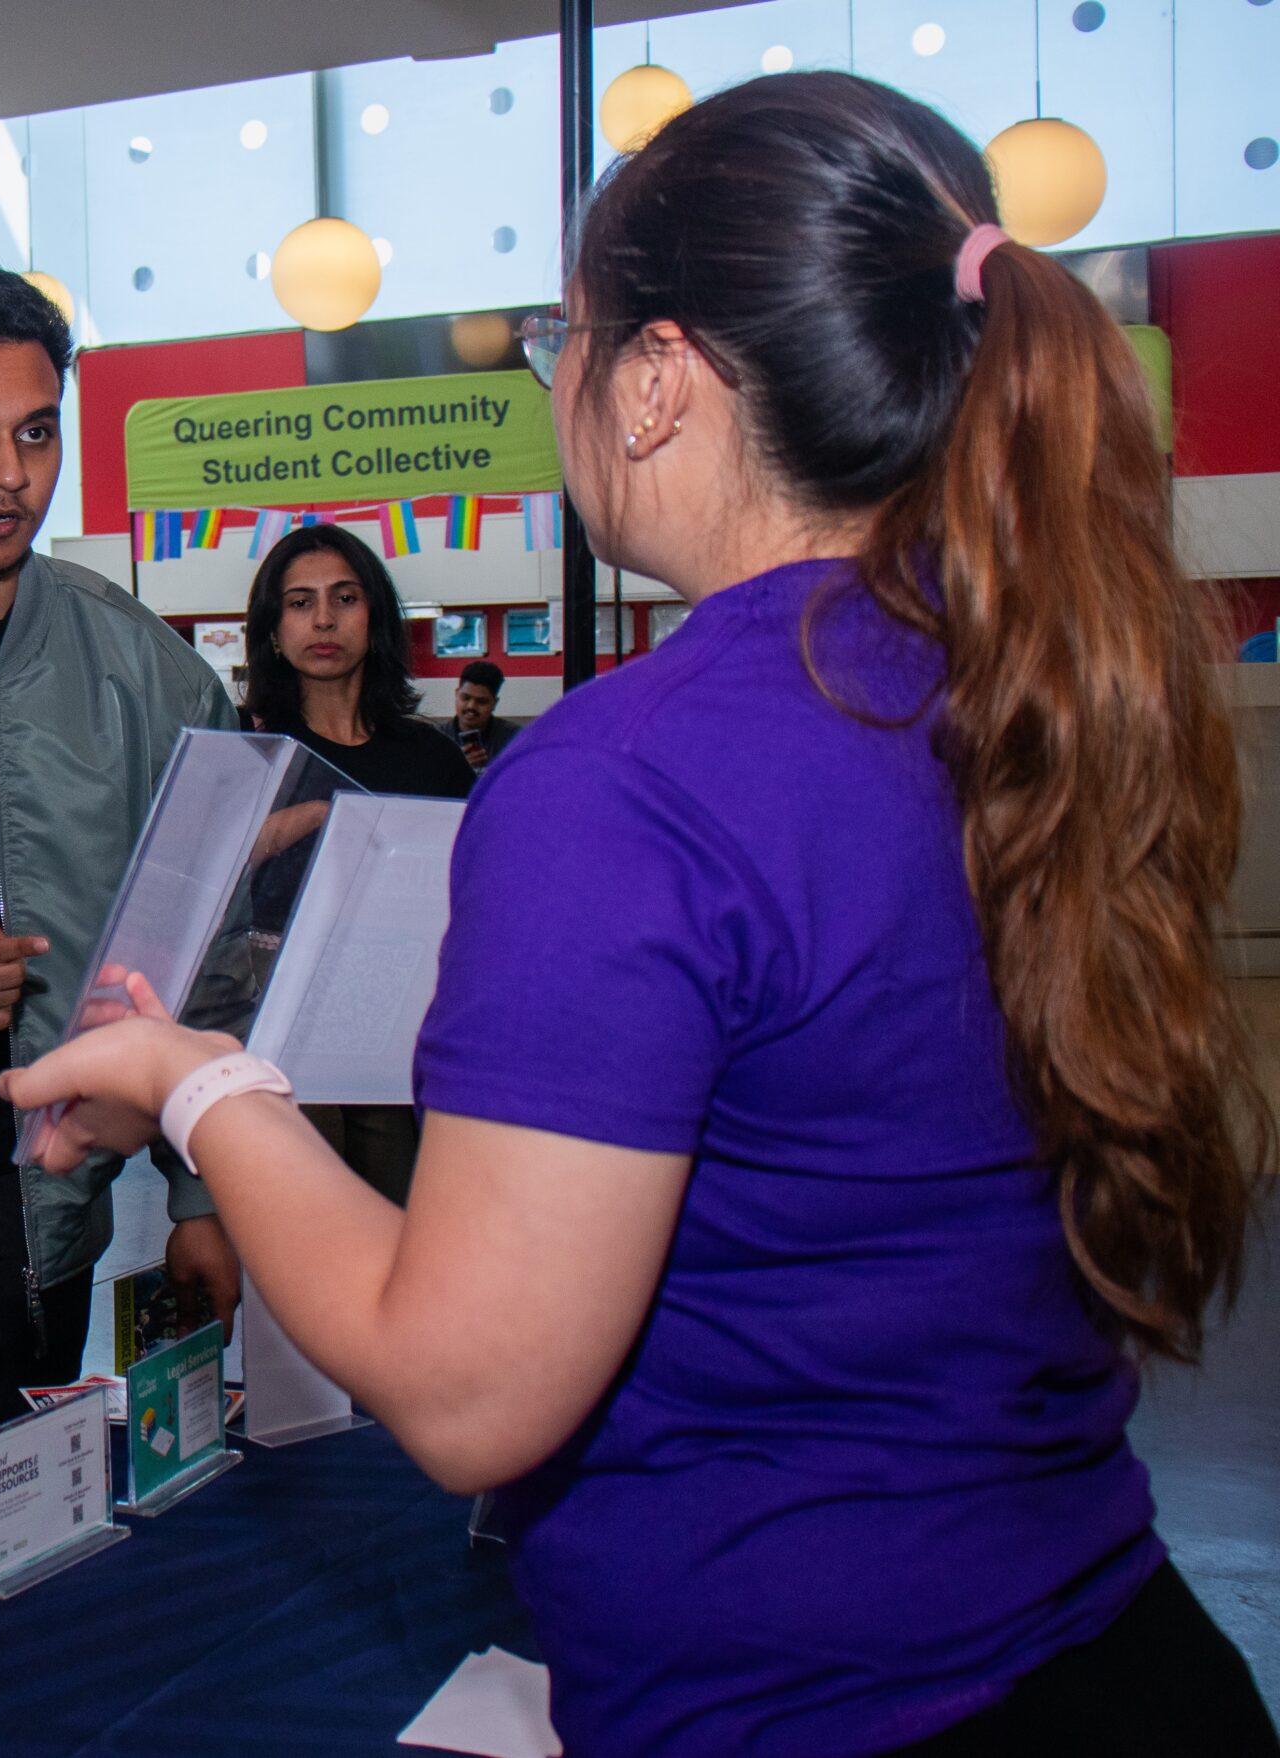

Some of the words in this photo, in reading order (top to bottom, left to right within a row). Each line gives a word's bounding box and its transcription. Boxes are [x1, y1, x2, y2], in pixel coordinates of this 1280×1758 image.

[174, 410, 313, 443] Queering
[323, 396, 511, 431] Community
[202, 453, 321, 484] Student
[330, 444, 492, 477] Collective
[167, 1358, 187, 1381] Legal
[188, 1345, 218, 1369] Services
